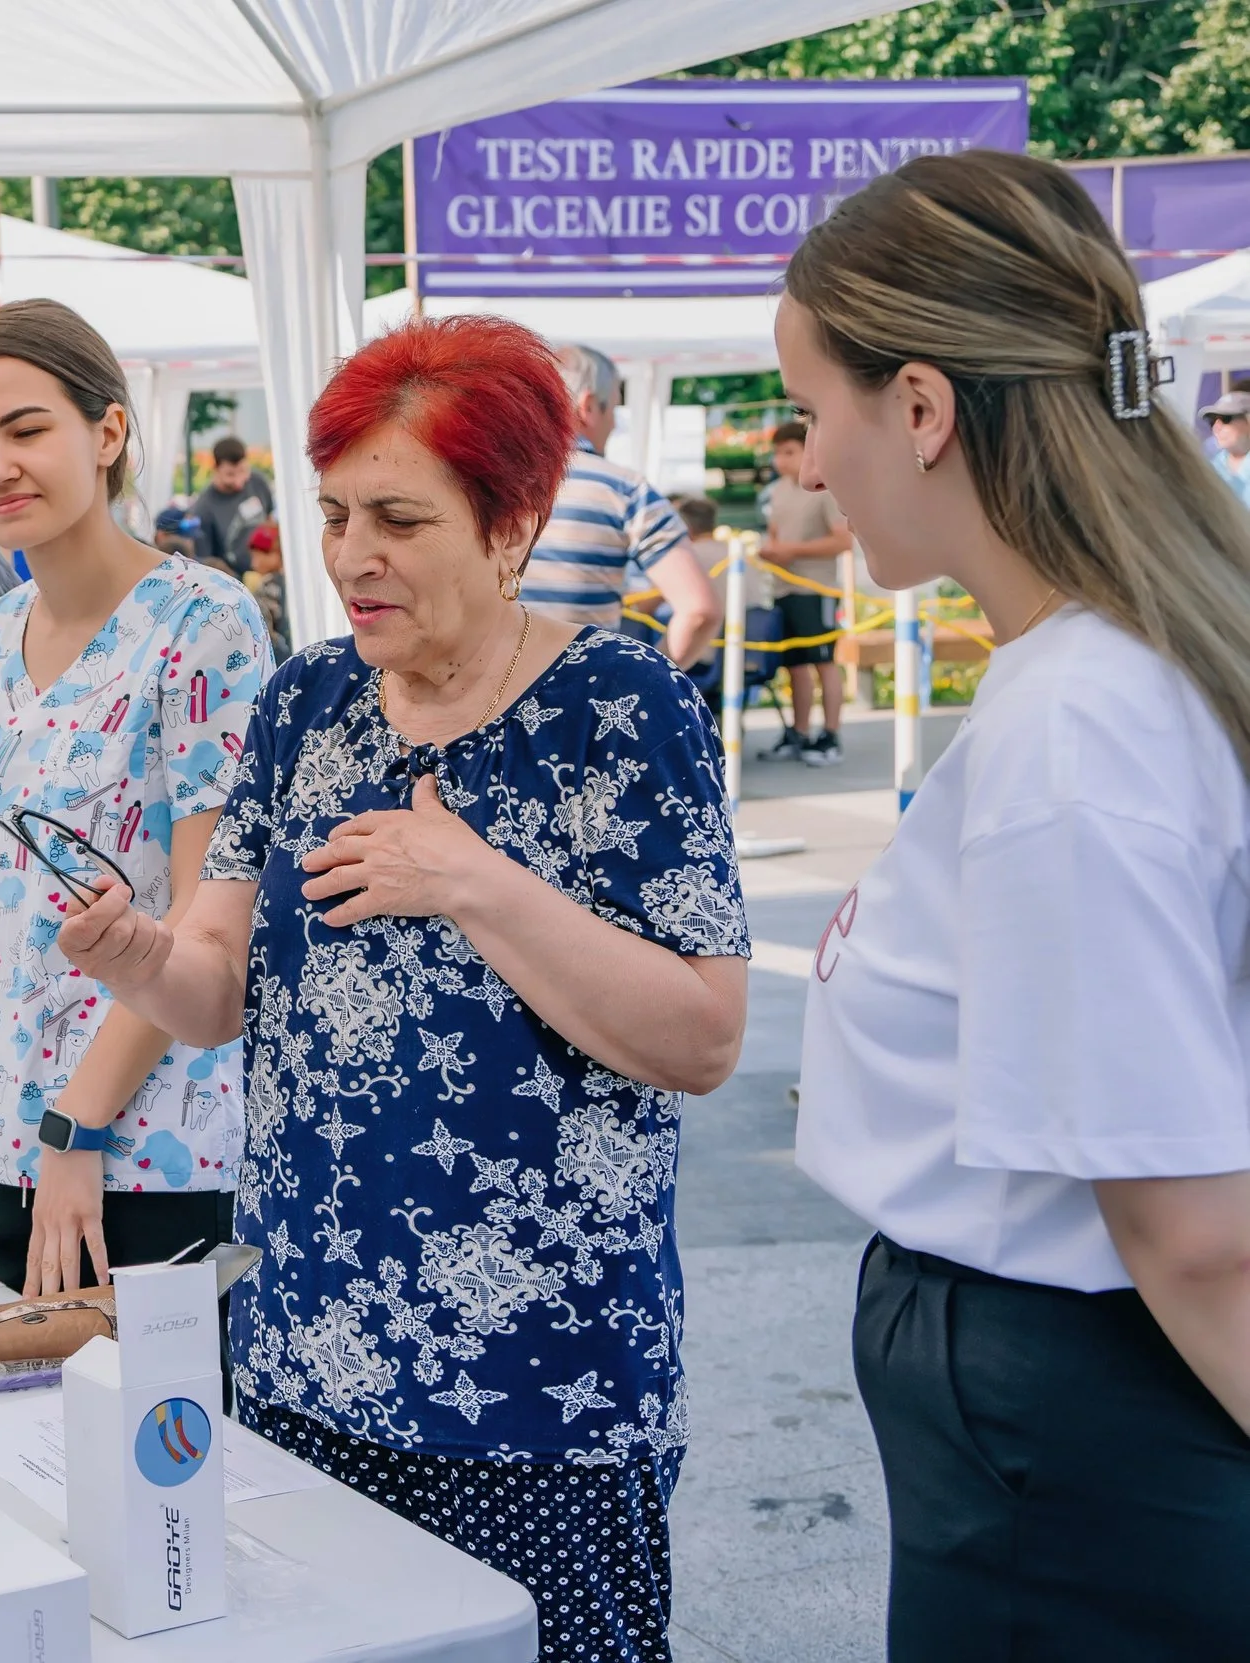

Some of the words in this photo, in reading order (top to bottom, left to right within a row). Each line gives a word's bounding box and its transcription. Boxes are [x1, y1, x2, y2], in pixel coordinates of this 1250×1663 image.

[477, 137, 617, 181] TESTE
[631, 137, 794, 181] RAPIDE
[447, 195, 672, 238] GLICEMIE
[684, 194, 724, 236] SI
[166, 1506, 182, 1611] GAOYE
[184, 1547, 193, 1594] Designers
[33, 1609, 45, 1663] GAOY
